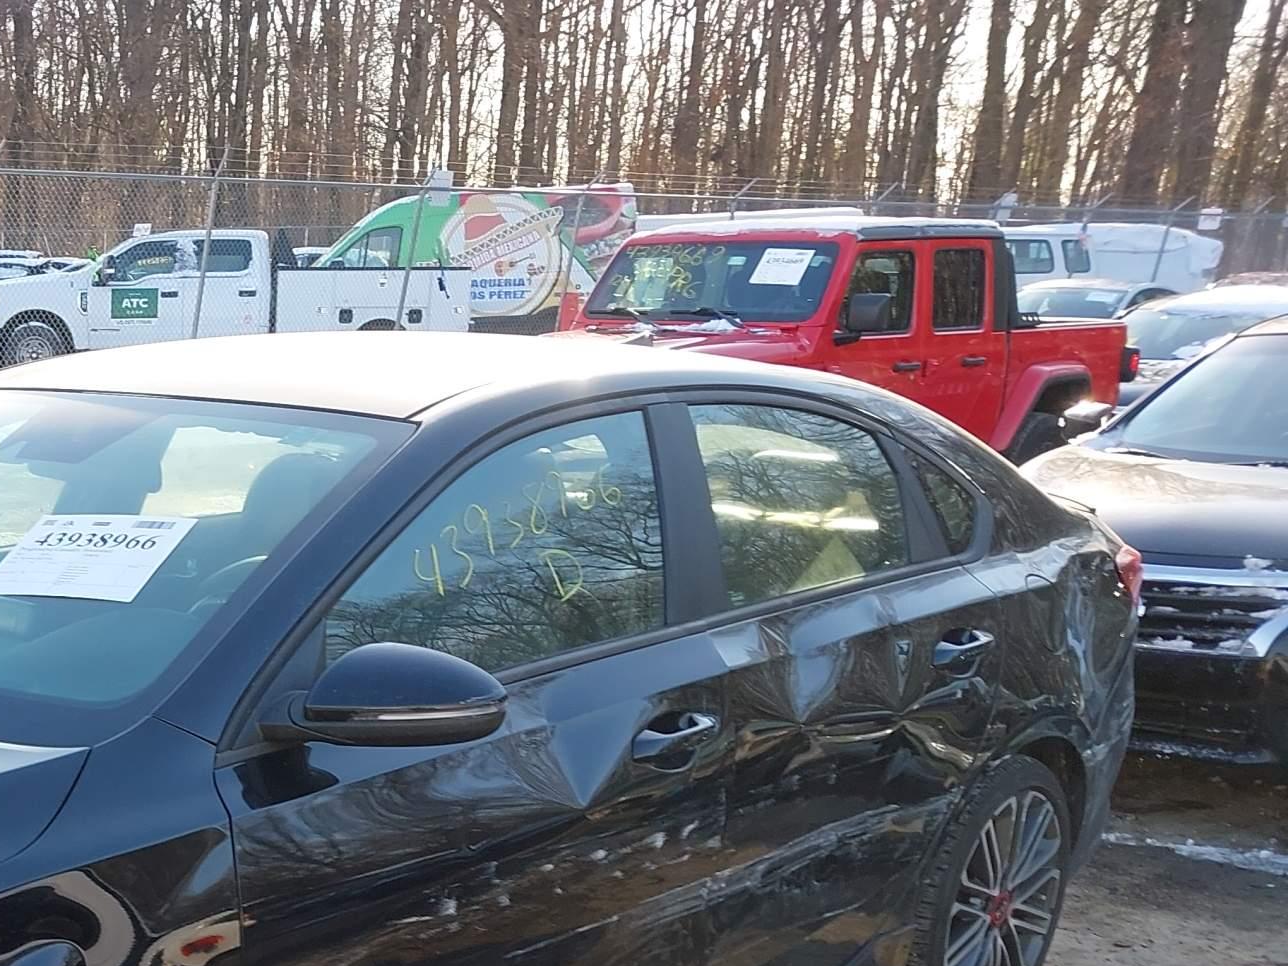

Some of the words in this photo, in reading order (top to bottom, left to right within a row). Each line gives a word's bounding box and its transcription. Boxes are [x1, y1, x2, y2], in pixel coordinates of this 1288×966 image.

[470, 278, 526, 289] AQUERIA
[470, 290, 486, 300] OS
[121, 298, 149, 309] ATC
[35, 532, 162, 551] 43938966
